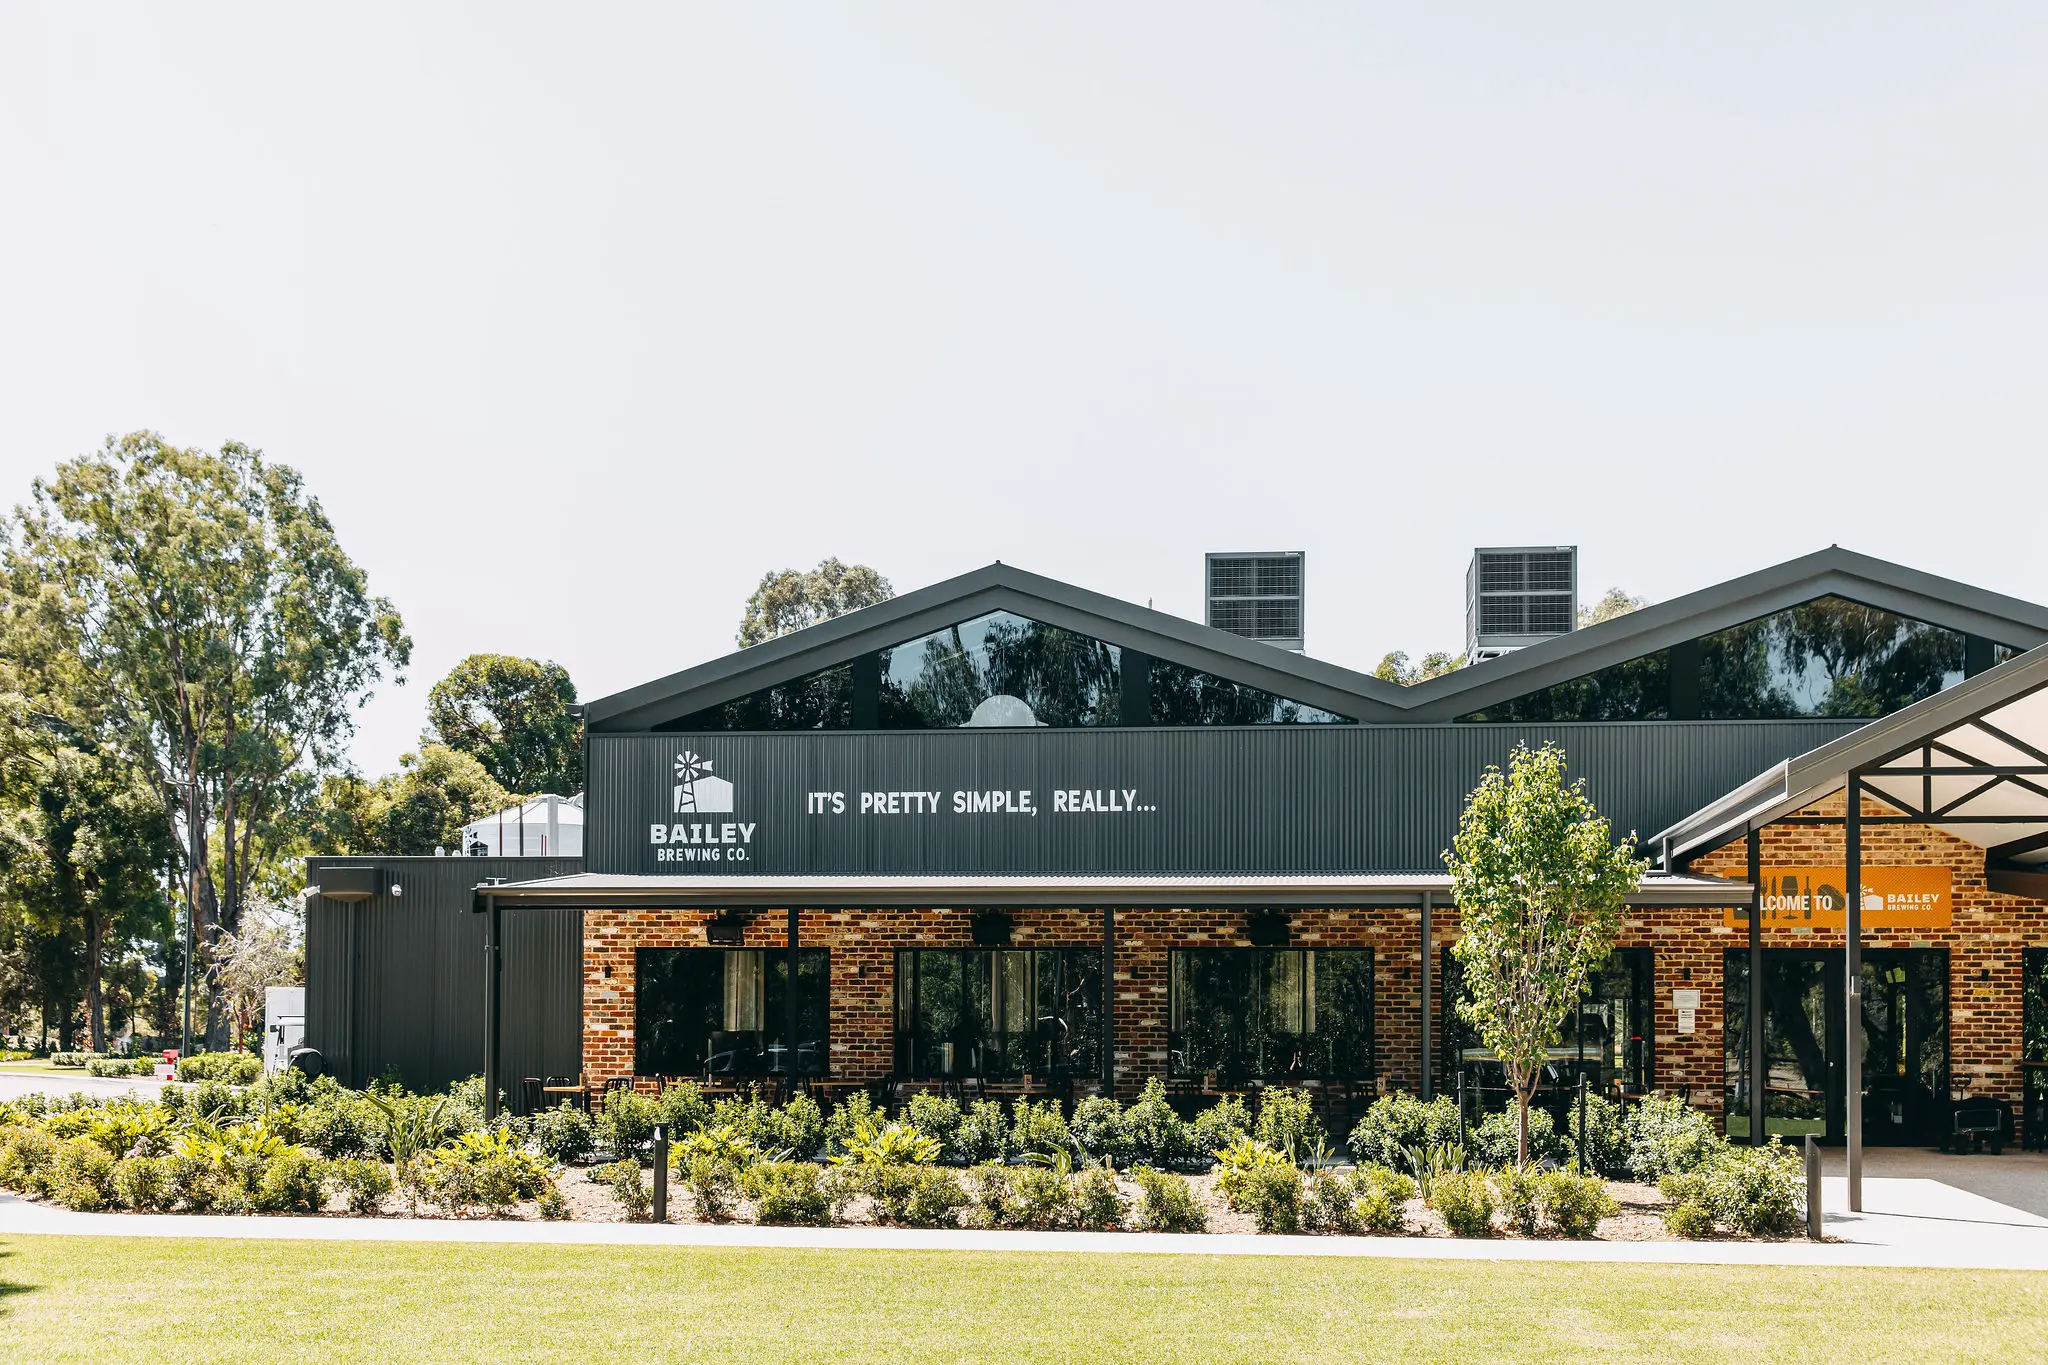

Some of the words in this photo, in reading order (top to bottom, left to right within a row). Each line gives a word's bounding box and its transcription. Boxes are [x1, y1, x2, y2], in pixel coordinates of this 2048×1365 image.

[808, 791, 845, 815] IT'S
[860, 791, 942, 814] PRETTY
[953, 790, 1038, 817] SIMPLE,
[1053, 789, 1157, 813] REALLY...
[650, 822, 757, 844] BAILEY
[657, 848, 720, 862] BREWING
[726, 847, 750, 861] CO.
[1759, 895, 1810, 911] LCOME
[1813, 894, 1833, 911] TO
[1887, 893, 1940, 903] BAILEY
